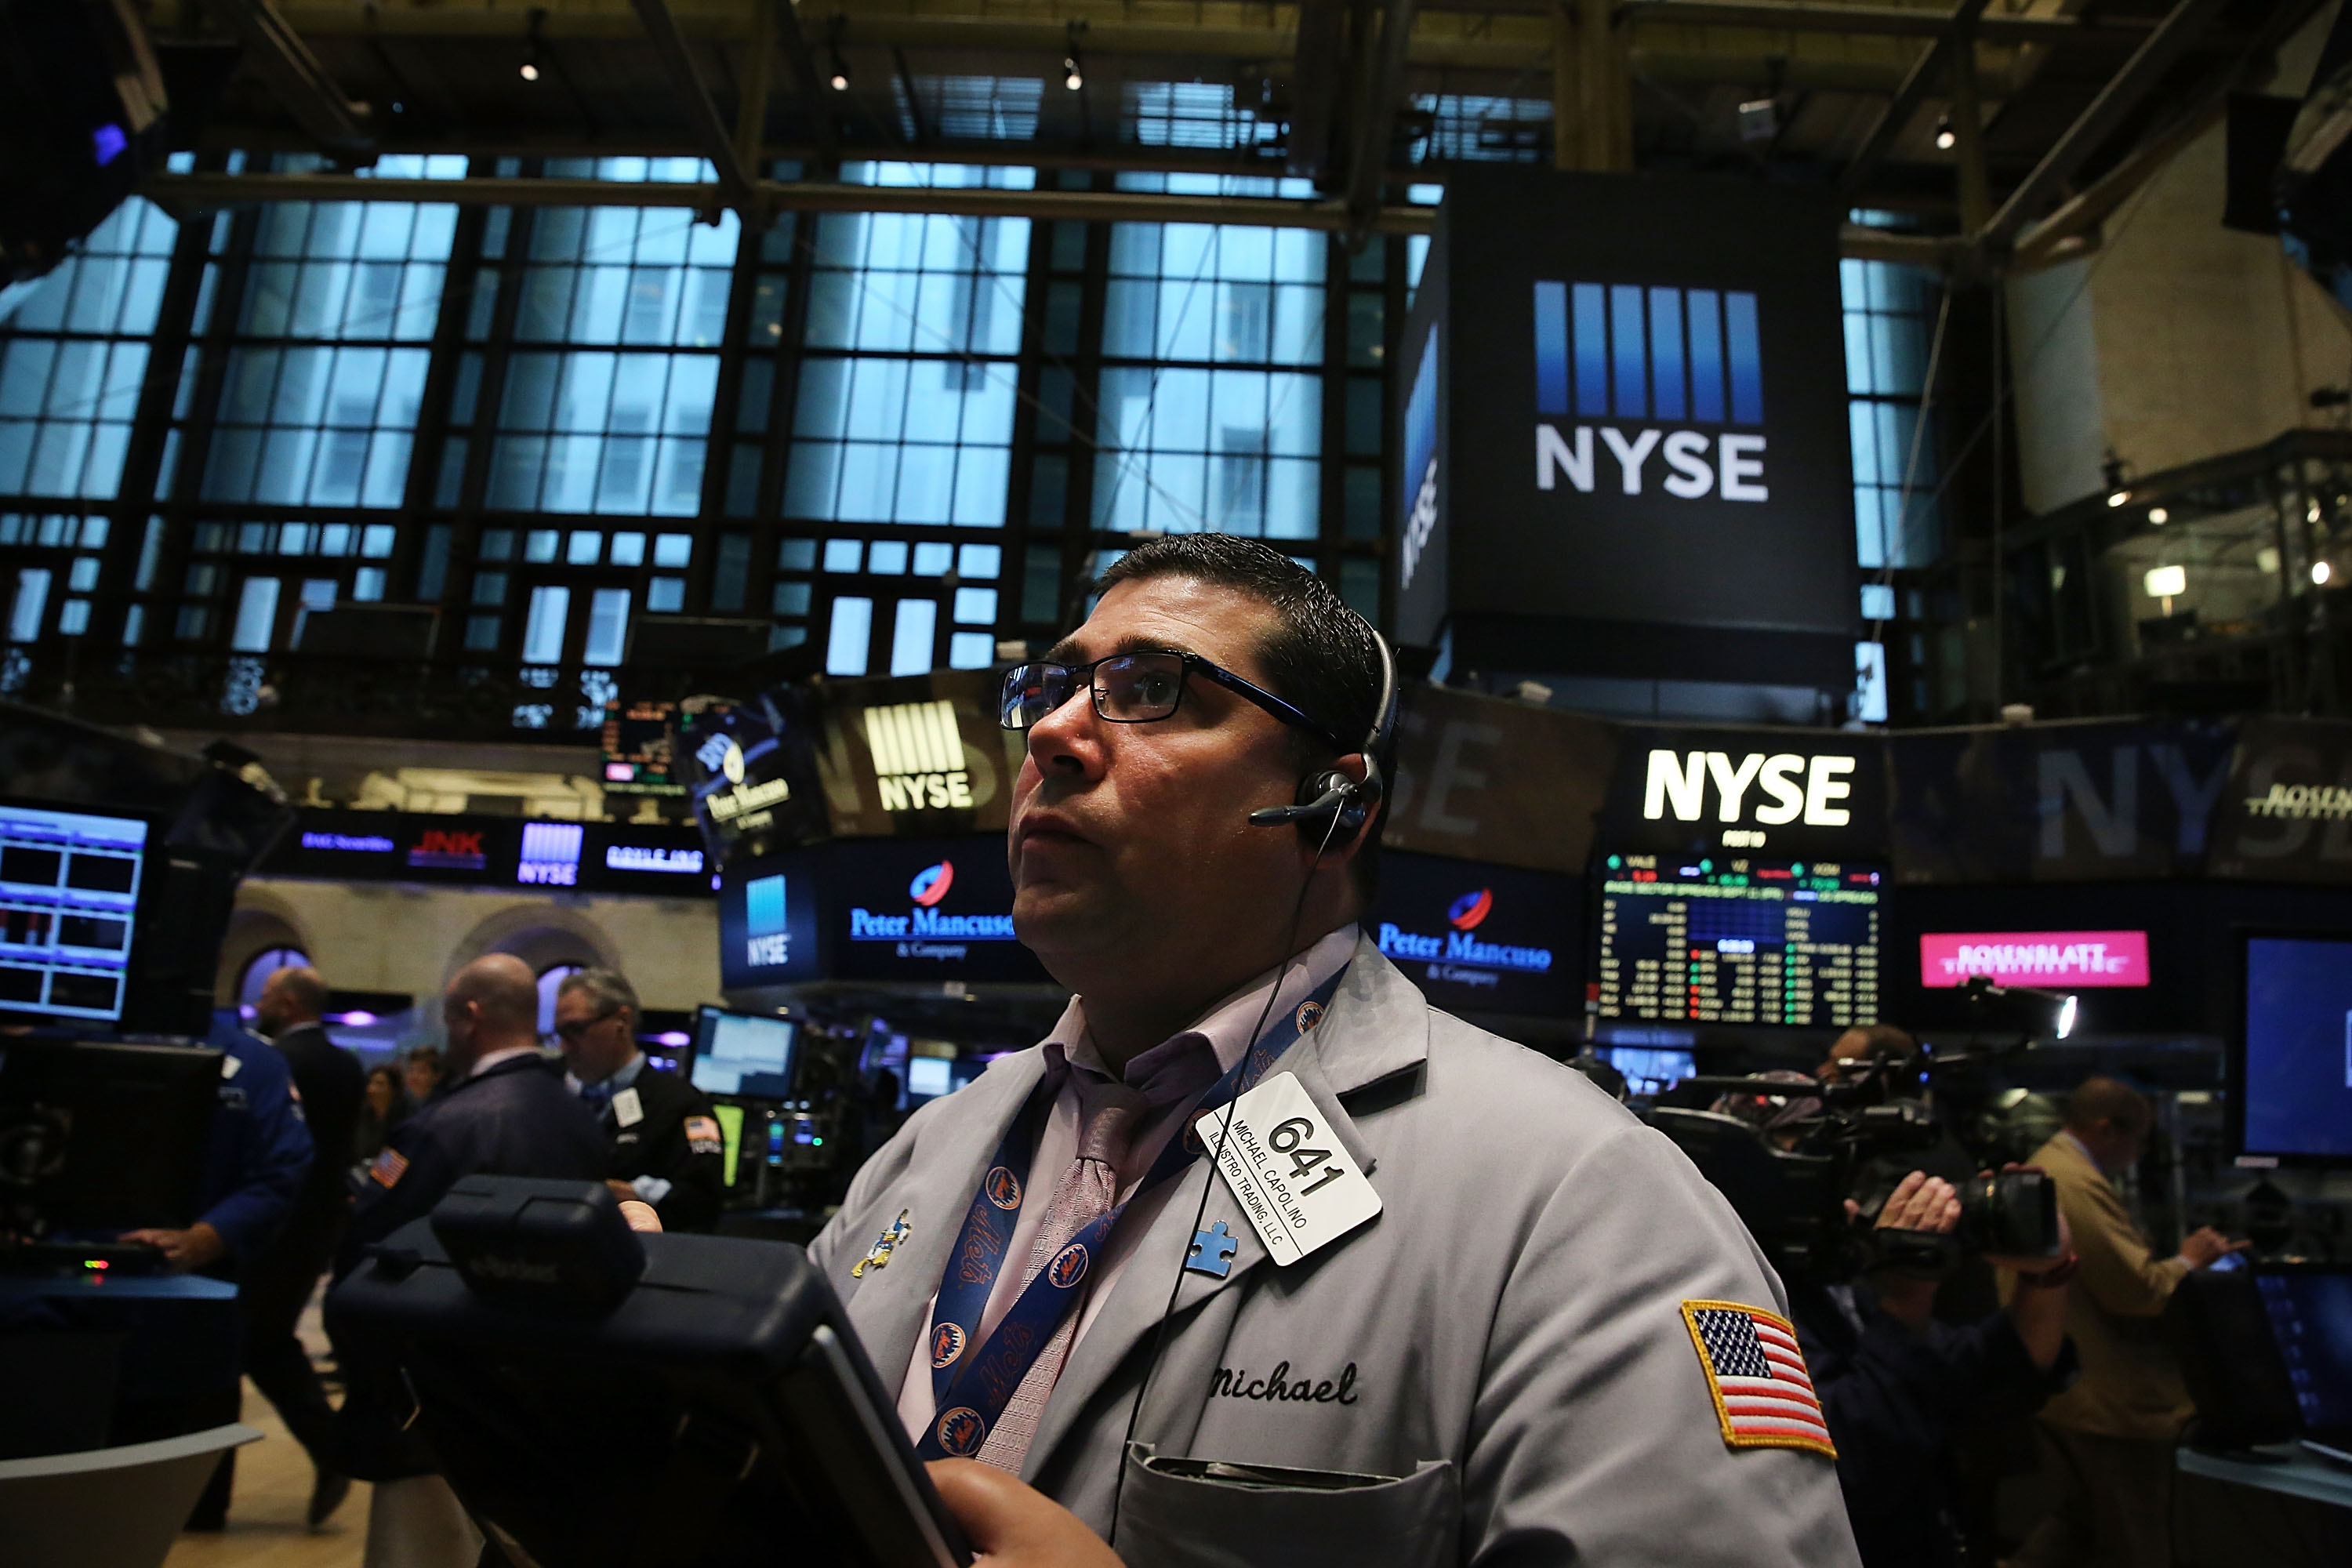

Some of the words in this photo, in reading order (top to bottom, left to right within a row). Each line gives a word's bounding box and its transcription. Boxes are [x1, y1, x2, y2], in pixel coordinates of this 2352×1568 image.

[1535, 423, 1769, 503] NYSE
[877, 771, 974, 812] NYSE
[1643, 749, 1857, 826] NYSE
[414, 829, 486, 856] JNK
[517, 862, 580, 886] NYSE
[747, 933, 789, 967] NYSE
[850, 907, 909, 936] Peter
[1378, 921, 1443, 958] Peter
[1445, 930, 1552, 970] Mancuso
[1232, 1118, 1269, 1171] MICHAEL
[1263, 1170, 1308, 1229] CAPOLINO
[1268, 1116, 1345, 1197] 641
[1236, 1176, 1269, 1225] TRADING,
[1263, 1221, 1283, 1246] LLC
[959, 1203, 1004, 1286] Mets
[978, 1321, 1035, 1411] Mets
[1209, 1360, 1358, 1405] Michael
